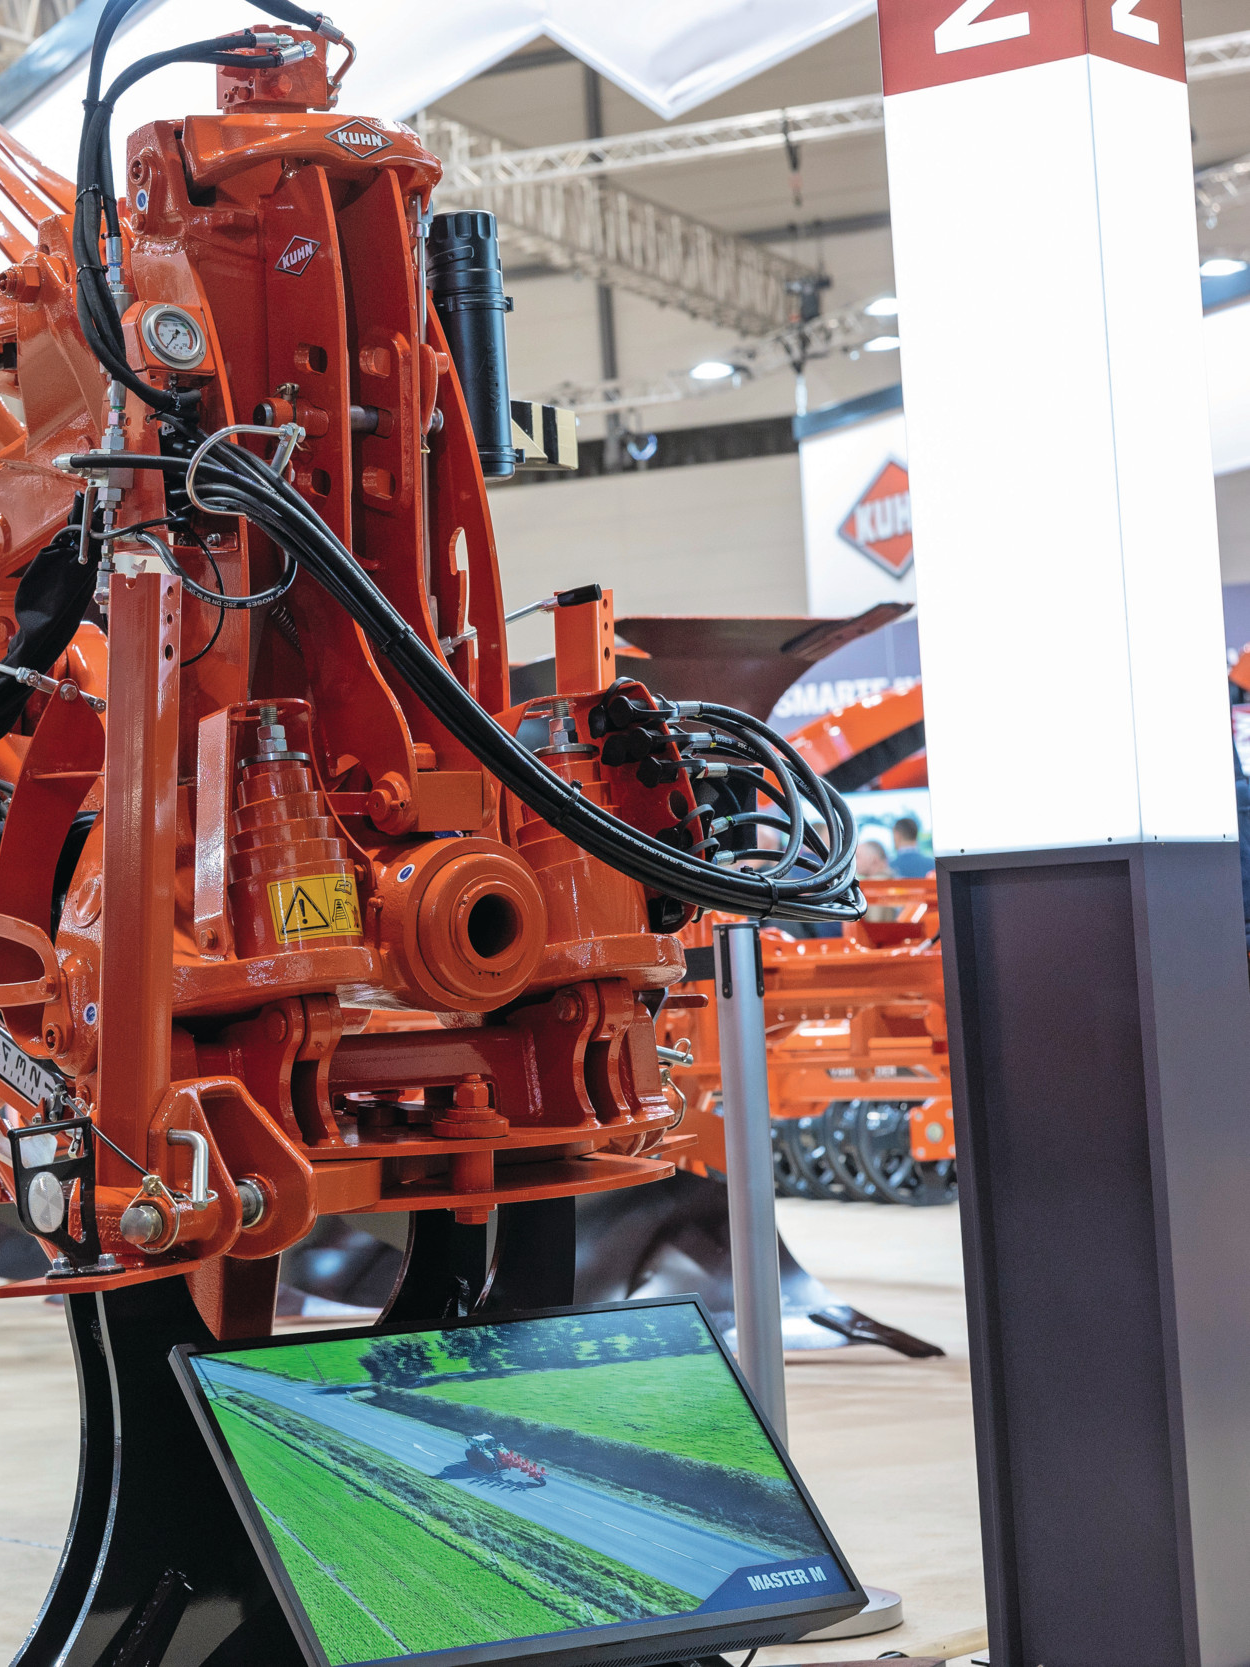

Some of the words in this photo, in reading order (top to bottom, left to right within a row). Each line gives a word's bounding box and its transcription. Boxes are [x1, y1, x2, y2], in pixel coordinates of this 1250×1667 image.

[337, 131, 383, 147] KUHN
[282, 242, 314, 269] KUHN
[246, 595, 274, 608] HOSES
[747, 1568, 810, 1591] MASTER
[808, 1566, 827, 1582] M
